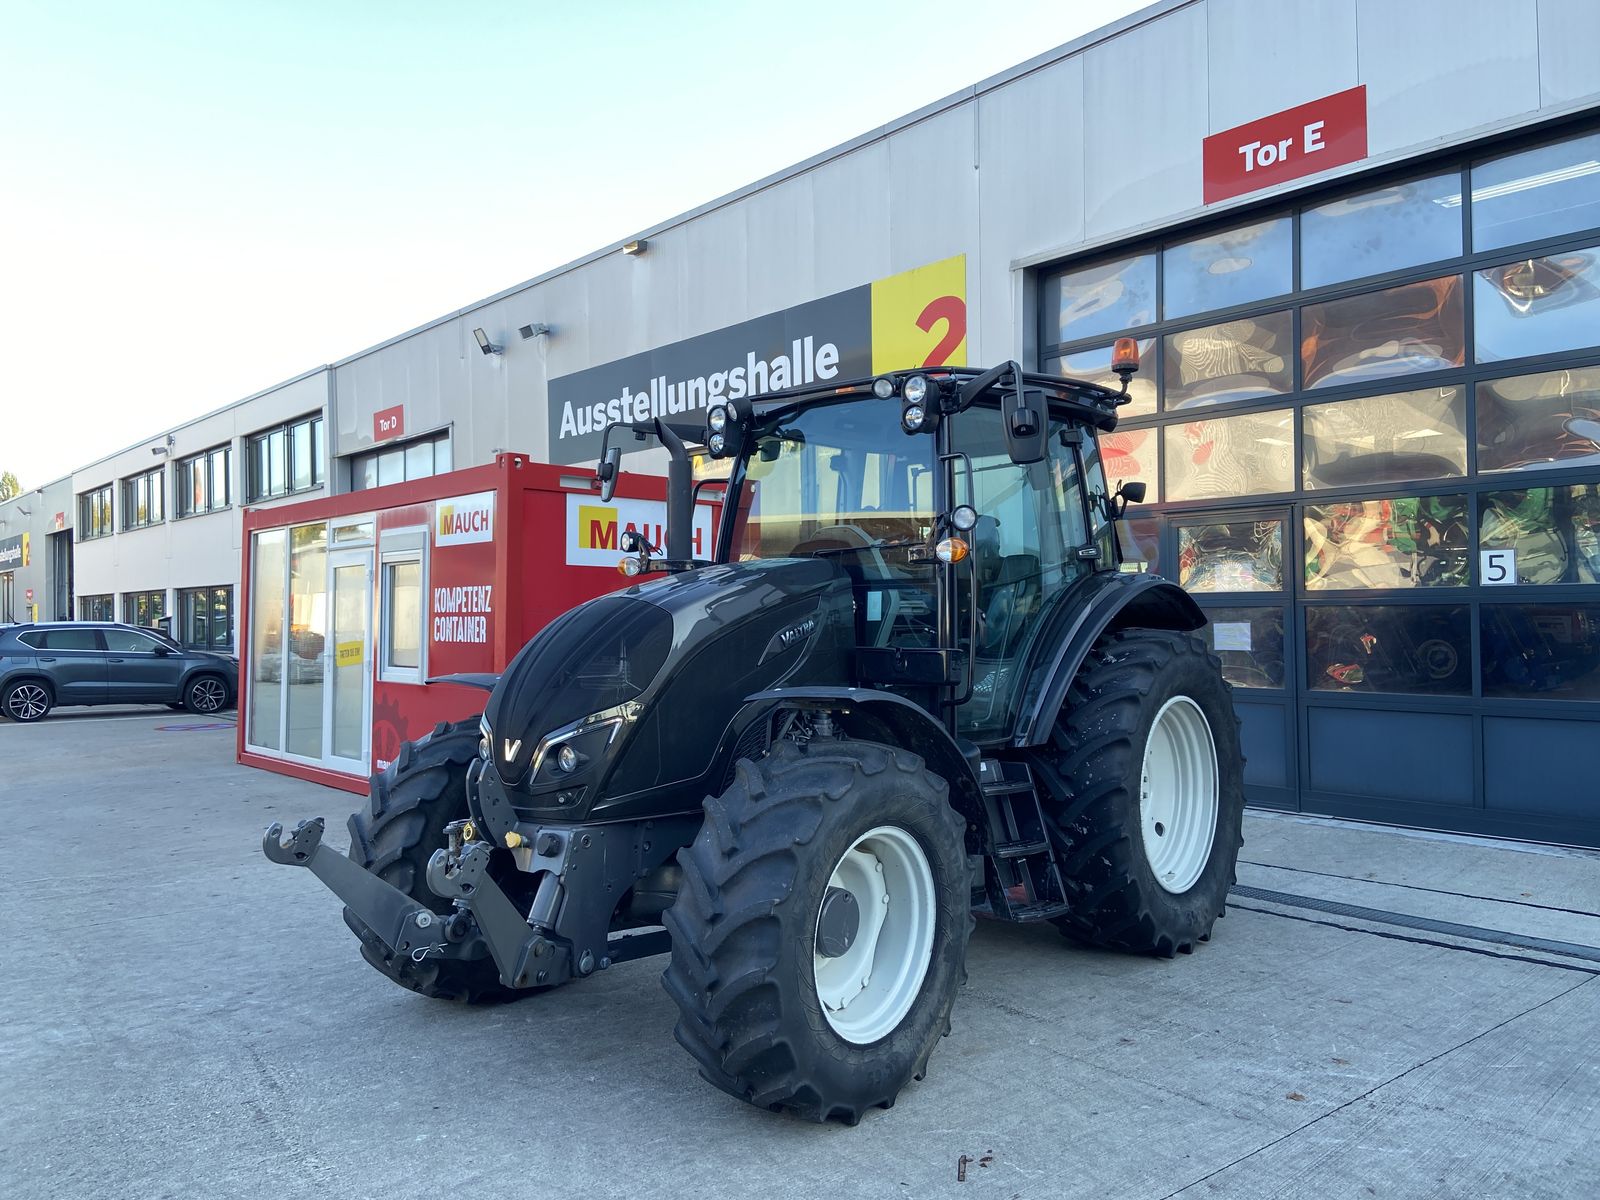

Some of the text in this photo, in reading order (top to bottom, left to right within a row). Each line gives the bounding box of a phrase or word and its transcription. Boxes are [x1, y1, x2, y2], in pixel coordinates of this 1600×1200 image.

[1238, 120, 1325, 172] Tor E
[559, 295, 967, 439] Ausstellungshalle 2
[380, 416, 397, 432] Tor D
[443, 509, 489, 535] MAUCH
[1487, 554, 1507, 582] 5
[434, 585, 492, 613] KOMPETENZ
[434, 616, 486, 643] CONTAINER
